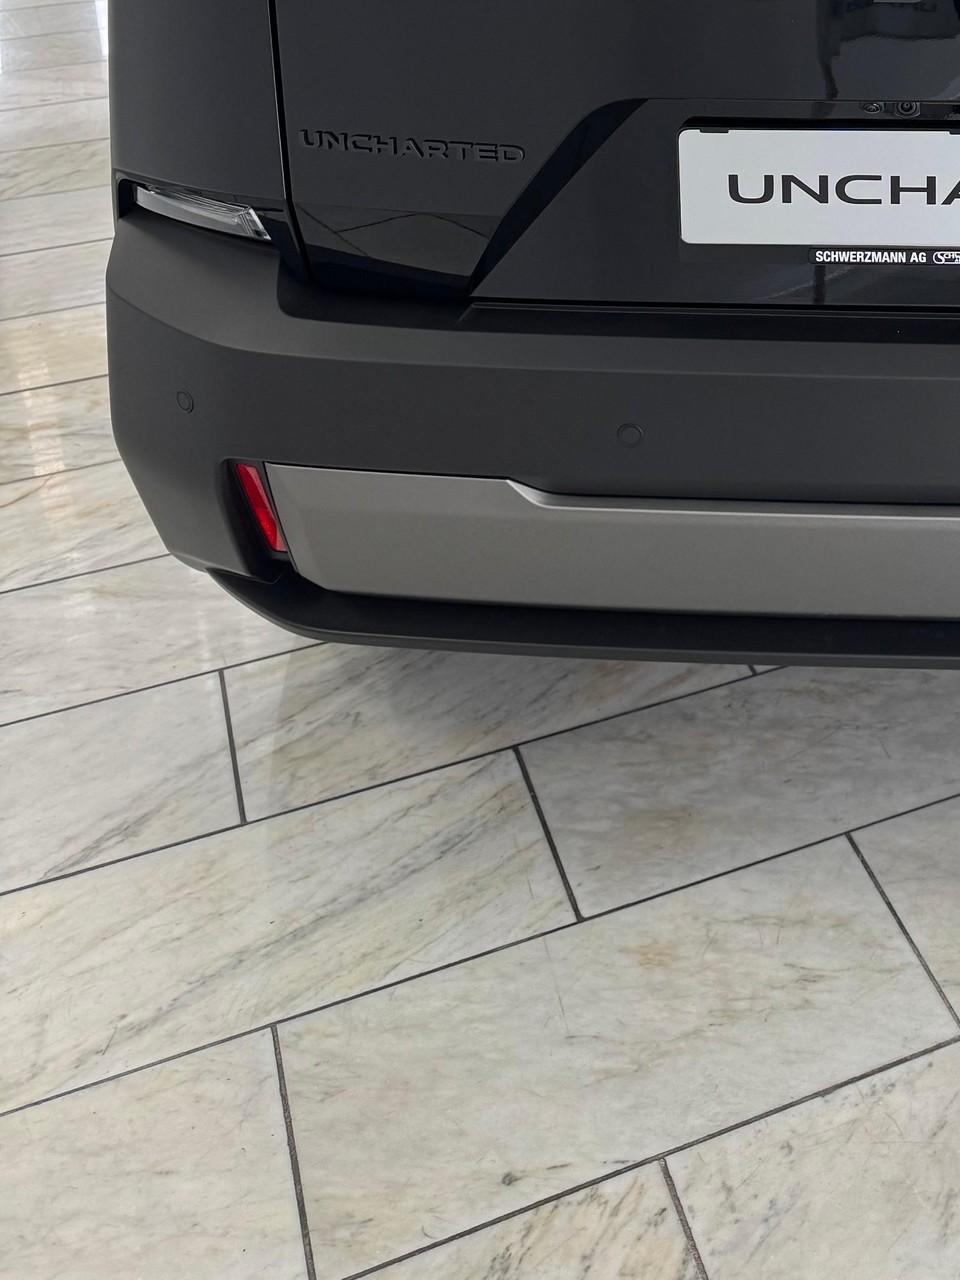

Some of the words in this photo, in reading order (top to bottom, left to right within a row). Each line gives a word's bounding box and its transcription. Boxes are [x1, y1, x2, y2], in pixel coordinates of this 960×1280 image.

[300, 129, 526, 162] UNCHARTED
[815, 250, 907, 263] SCHWERZMANN
[909, 251, 927, 263] AG
